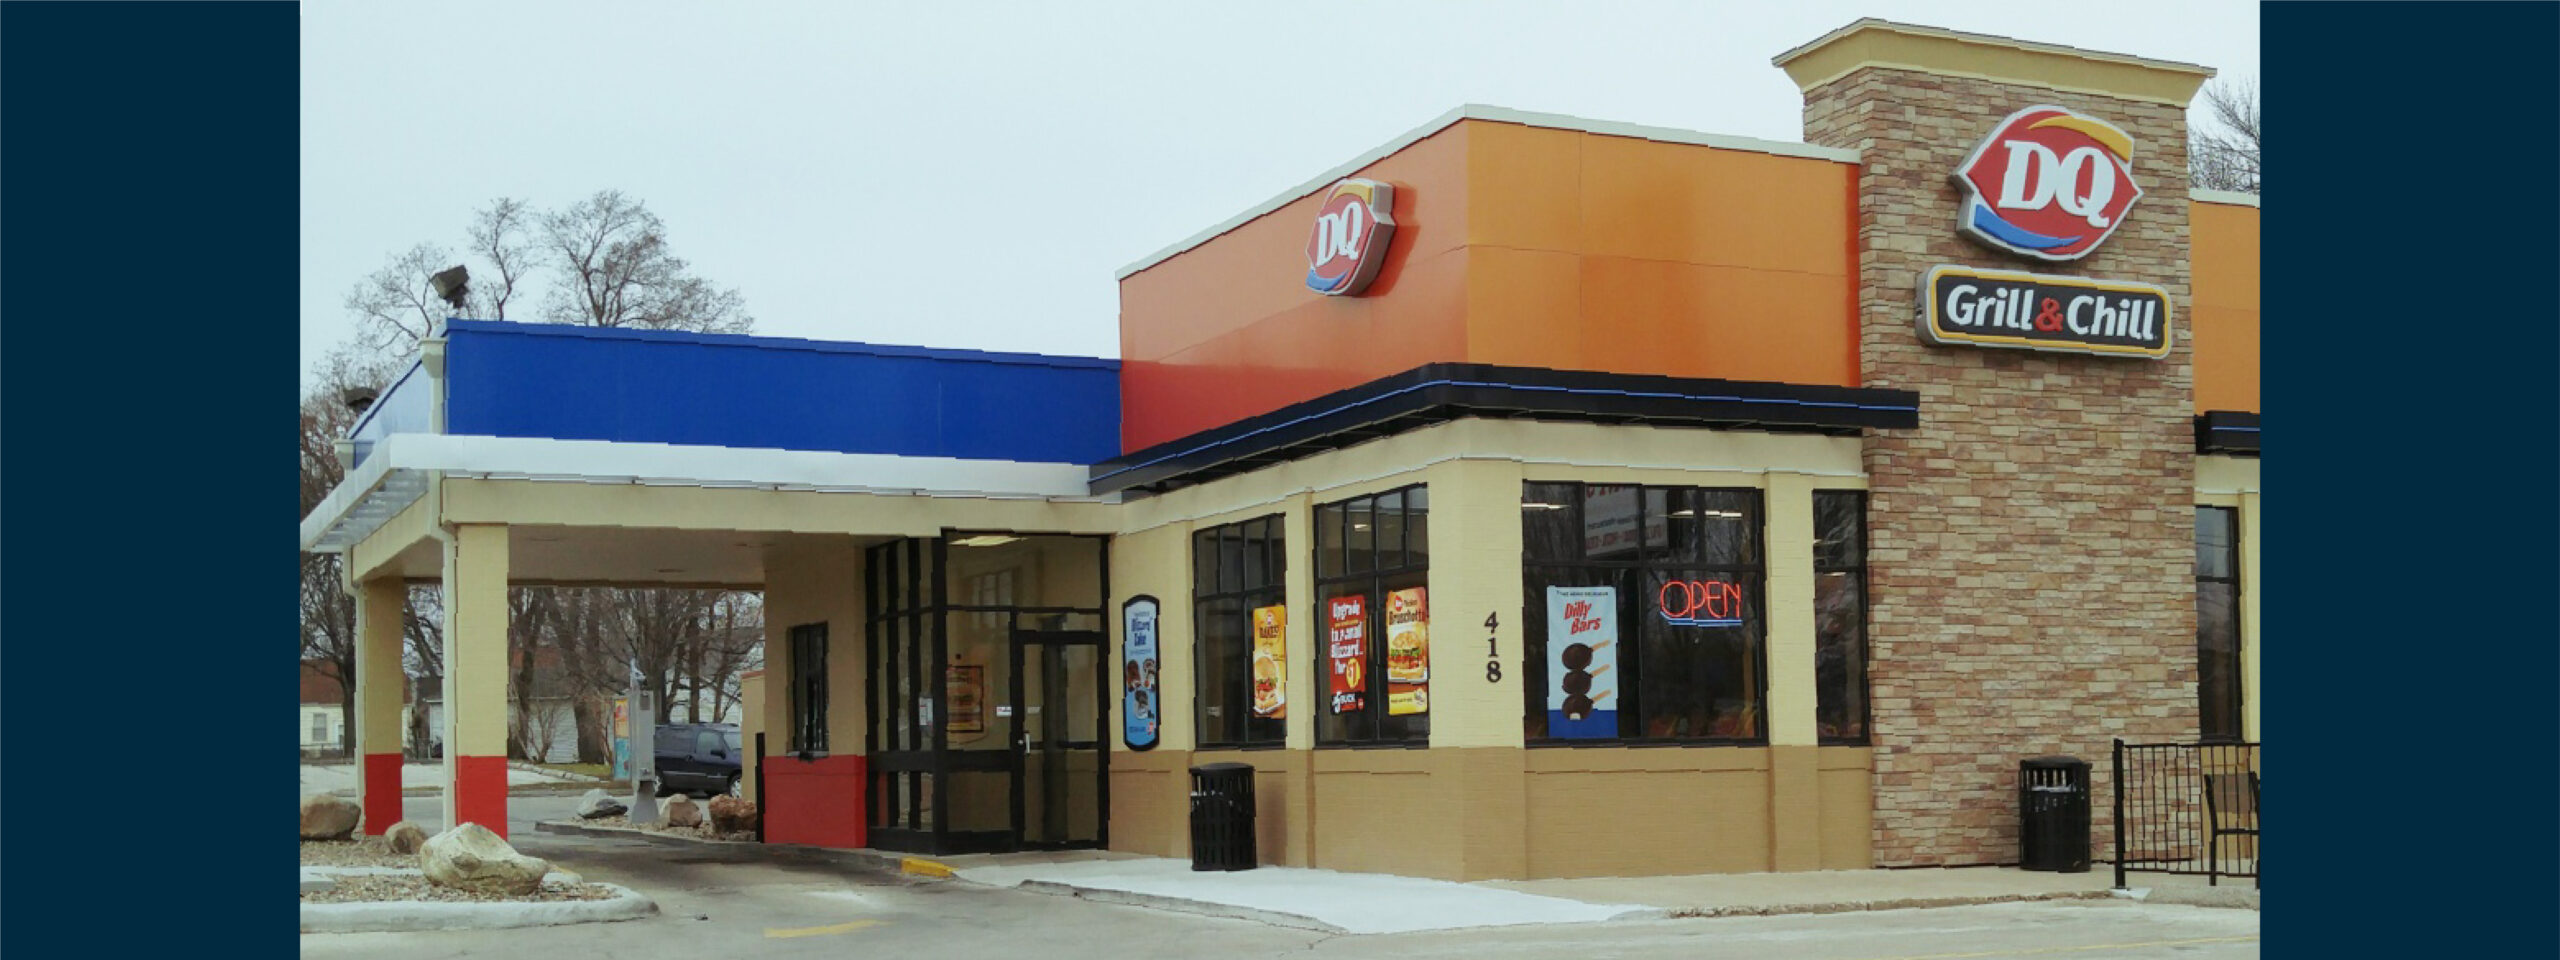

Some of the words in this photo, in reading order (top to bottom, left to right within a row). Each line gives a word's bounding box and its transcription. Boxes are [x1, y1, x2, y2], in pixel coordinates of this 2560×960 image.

[1997, 140, 2116, 228] DQ
[1316, 201, 1363, 267] DQ
[1946, 285, 2034, 331] Grill
[2067, 295, 2156, 341] Chill
[1564, 600, 1592, 620] Dilly
[1660, 580, 1741, 619] OPEN
[1571, 617, 1602, 636] Bars
